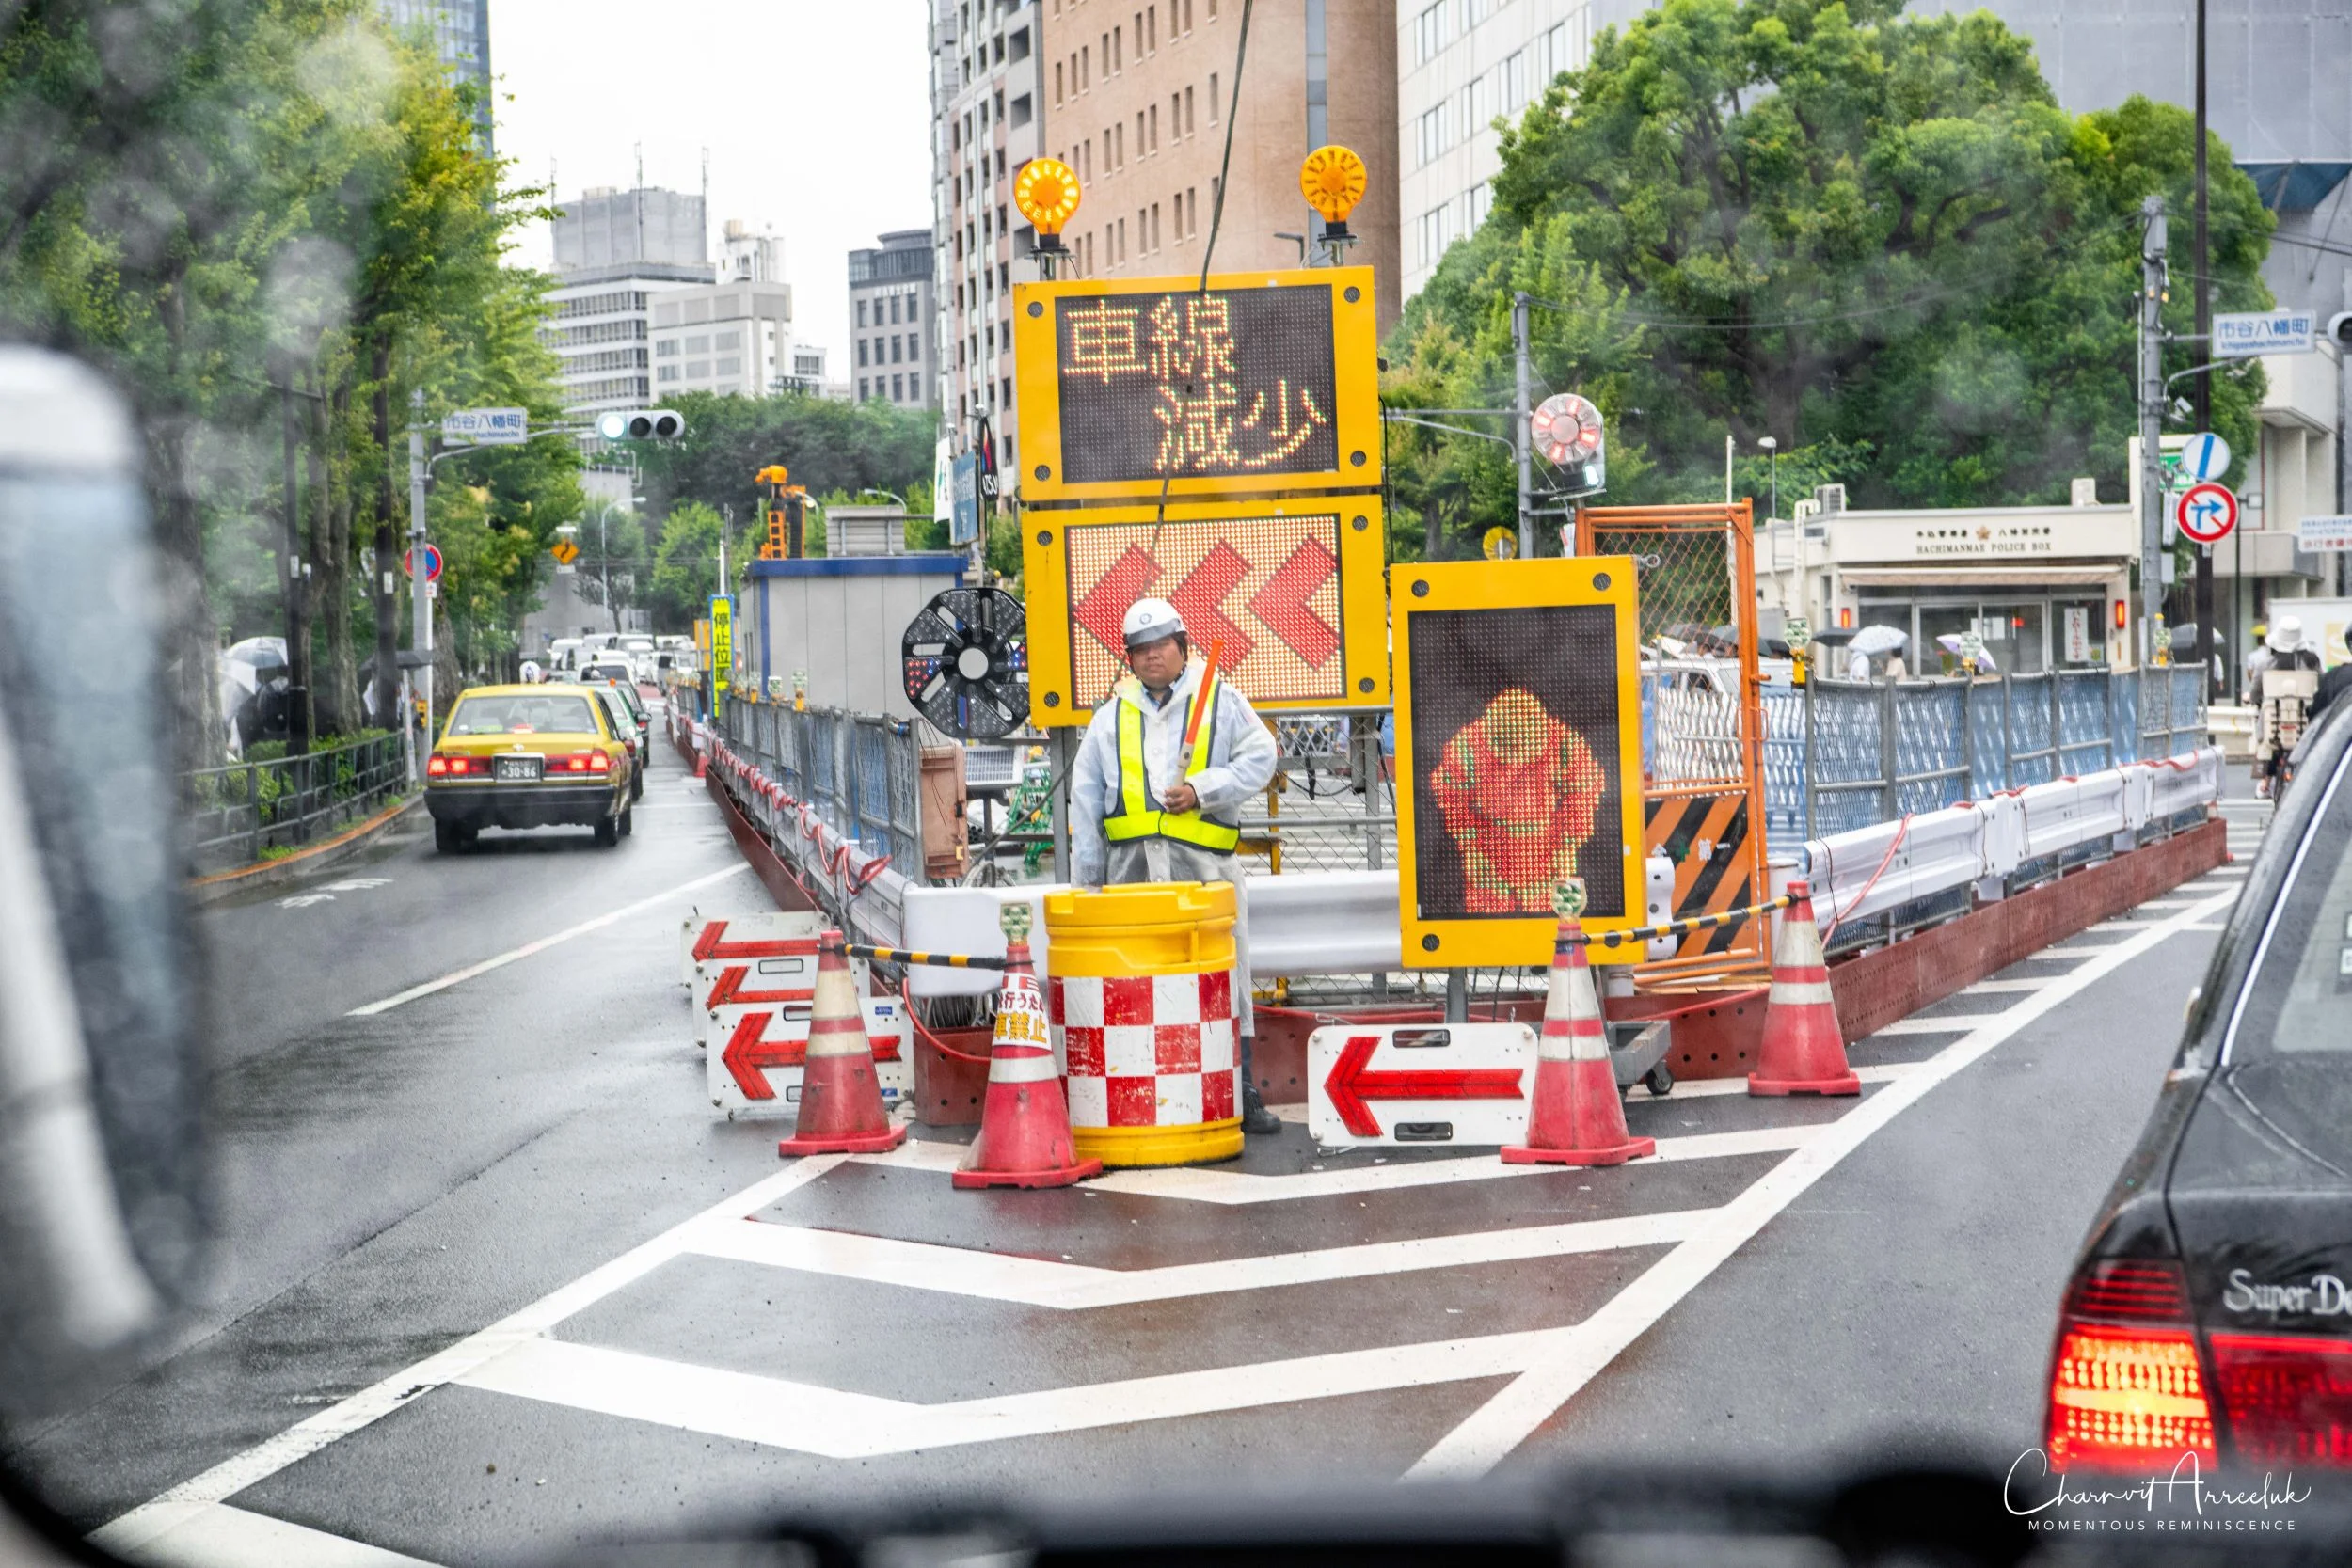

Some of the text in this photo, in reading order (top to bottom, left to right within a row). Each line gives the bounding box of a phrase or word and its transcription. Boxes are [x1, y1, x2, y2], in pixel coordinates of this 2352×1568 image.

[1062, 294, 1236, 384] 車線
[2218, 318, 2309, 338] 市谷八幡町
[1153, 379, 1327, 470] 減少
[1916, 542, 2052, 554] HACHIMANMAE POLICE BOX
[2222, 1268, 2312, 1321] Super
